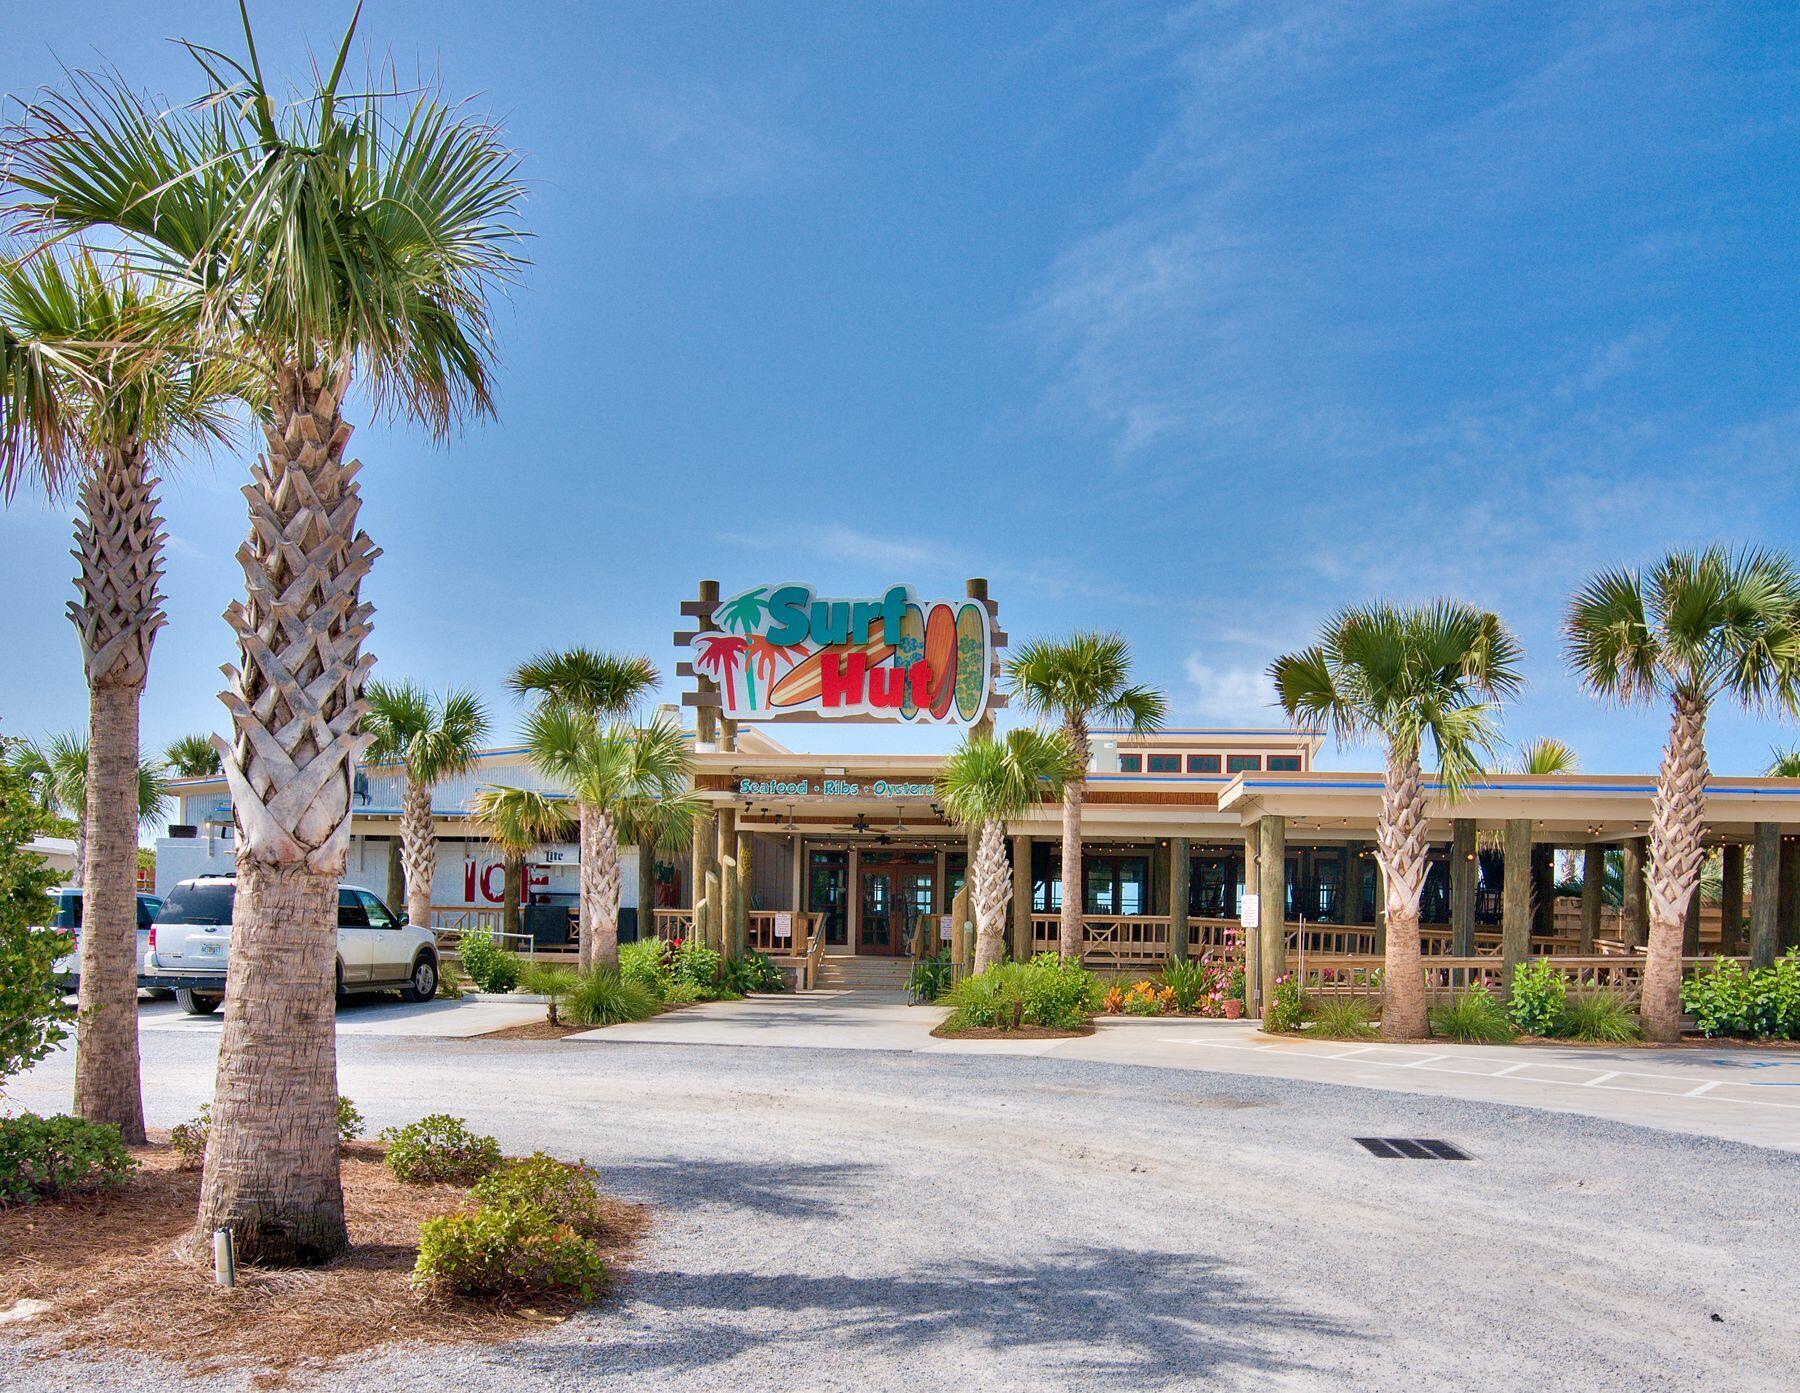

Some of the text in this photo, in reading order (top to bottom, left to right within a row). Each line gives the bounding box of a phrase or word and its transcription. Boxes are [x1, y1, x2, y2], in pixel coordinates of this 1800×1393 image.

[765, 585, 908, 647] Surf
[820, 651, 934, 709] Hut
[739, 778, 936, 798] Seafood Ribs Oysters
[546, 851, 564, 863] Lite
